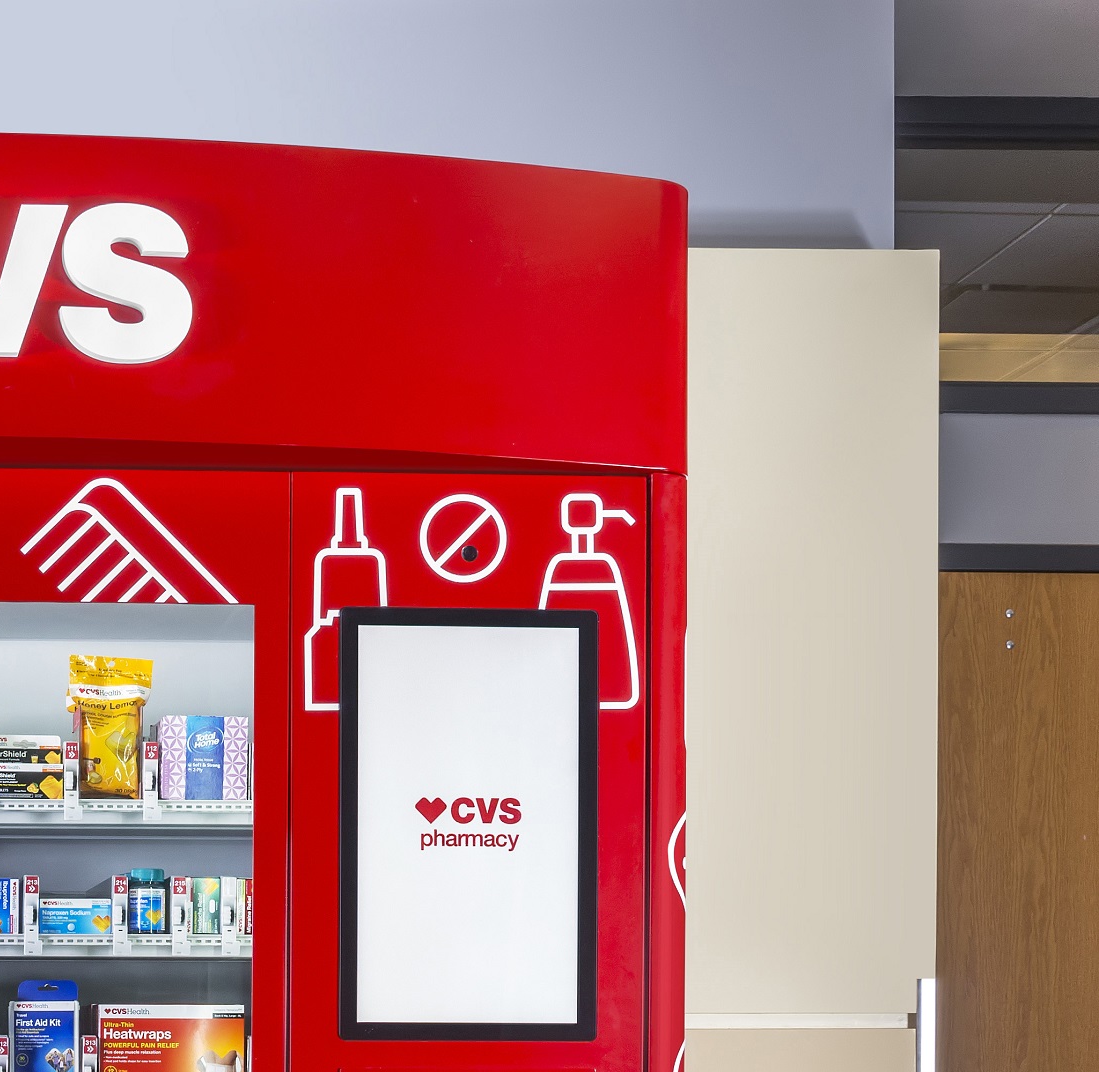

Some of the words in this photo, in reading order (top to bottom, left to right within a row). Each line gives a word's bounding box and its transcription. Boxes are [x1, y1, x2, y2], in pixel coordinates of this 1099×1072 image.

[86, 688, 122, 697] CVSHealth
[78, 700, 107, 710] Honey
[193, 737, 220, 747] Home
[451, 797, 522, 824] CVS
[421, 829, 519, 851] pharmacy
[104, 1029, 172, 1041] Heatwraps
